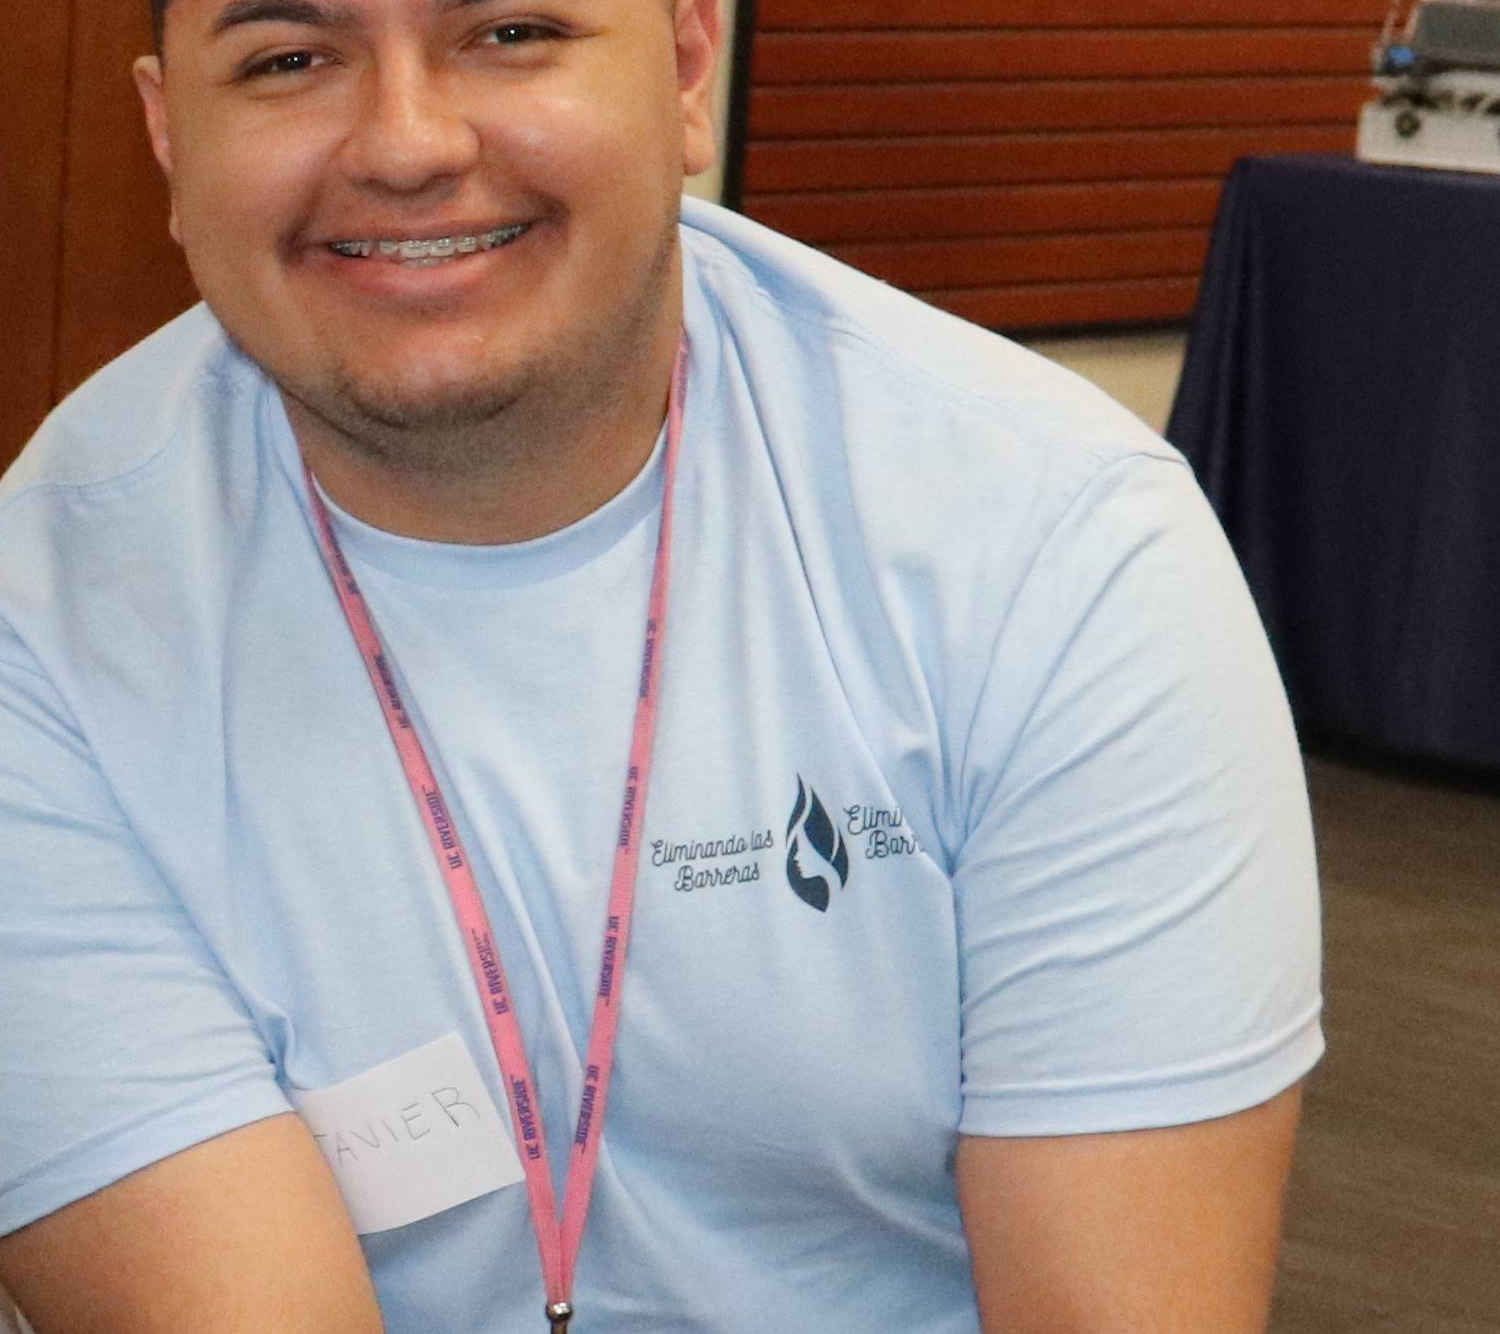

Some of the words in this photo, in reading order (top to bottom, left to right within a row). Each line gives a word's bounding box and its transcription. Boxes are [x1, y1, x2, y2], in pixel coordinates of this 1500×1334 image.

[650, 838, 748, 867] Eliminando
[750, 829, 774, 854] las
[673, 863, 761, 893] Barreras
